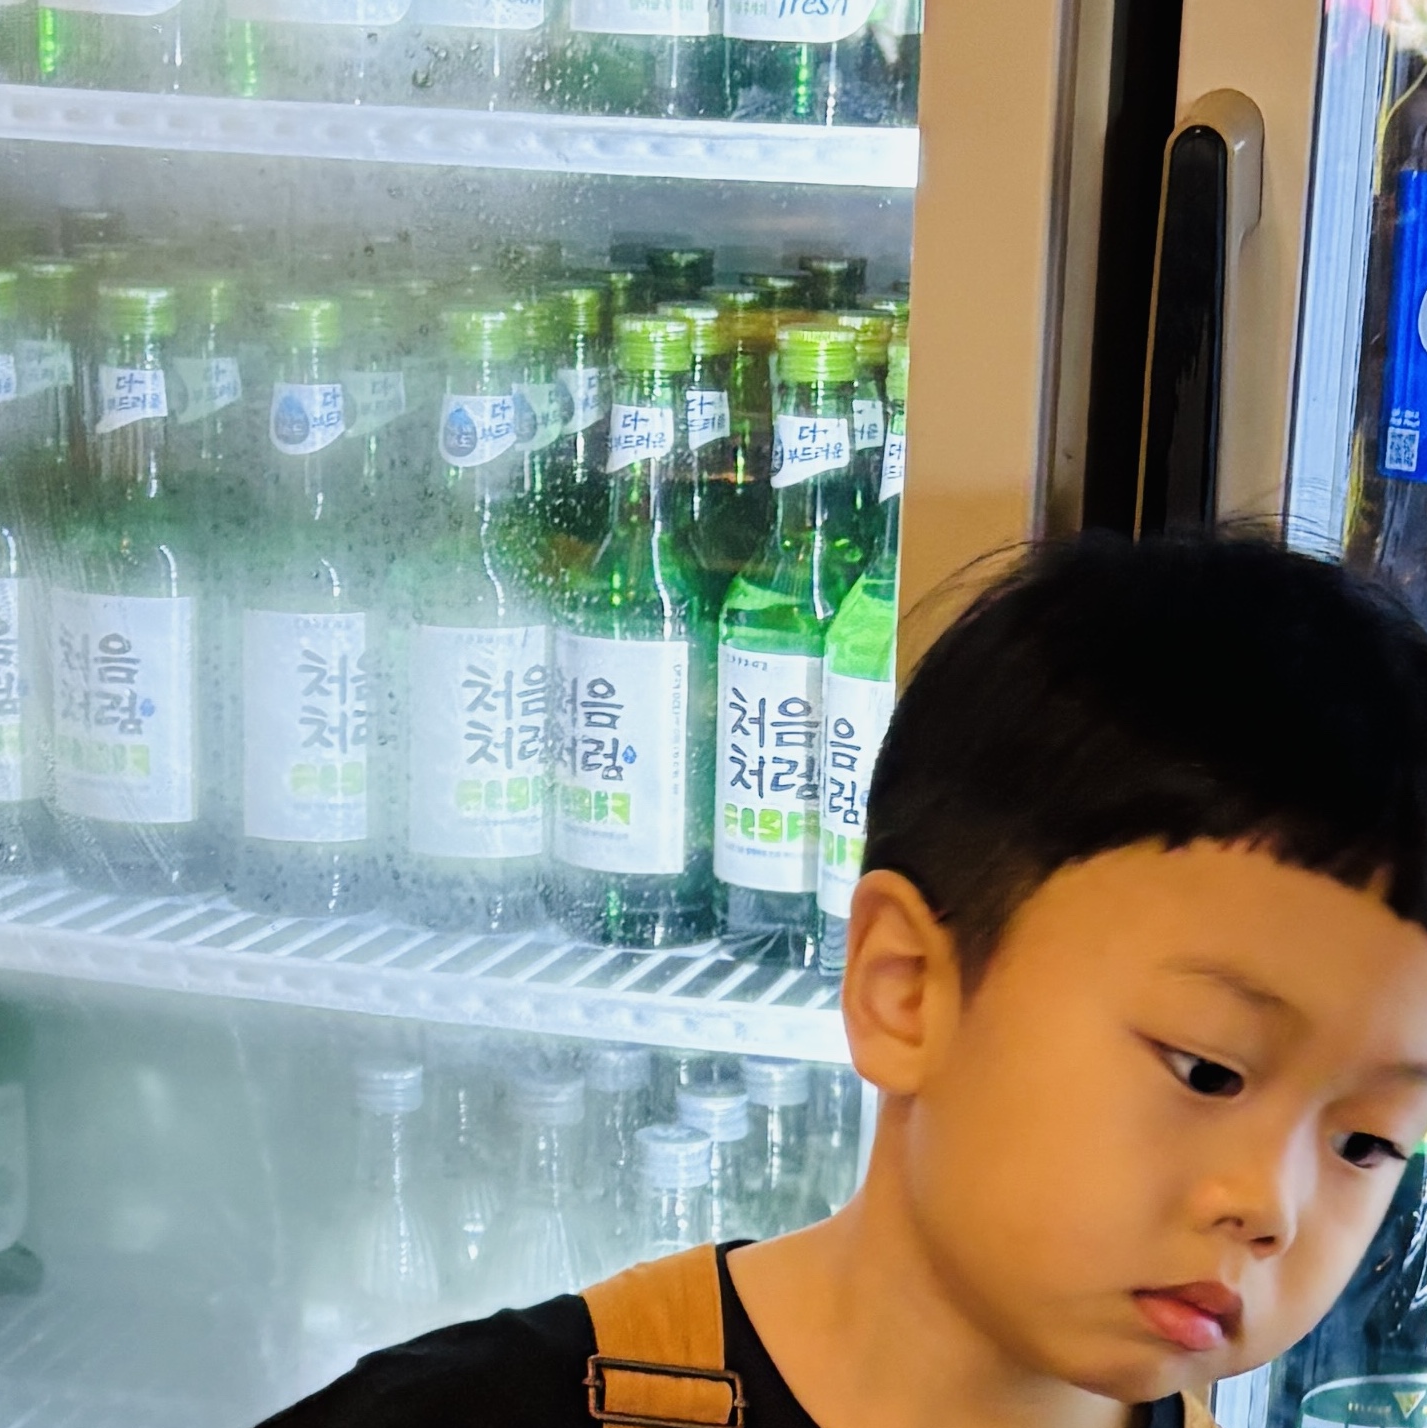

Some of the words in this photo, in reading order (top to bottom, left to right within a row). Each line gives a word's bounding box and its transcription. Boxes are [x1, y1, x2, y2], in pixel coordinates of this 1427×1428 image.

[788, 442, 844, 463] 부드러운
[729, 687, 822, 749] 처음
[825, 715, 862, 772] 음
[729, 743, 822, 800] 처럼
[825, 774, 861, 826] 럼
